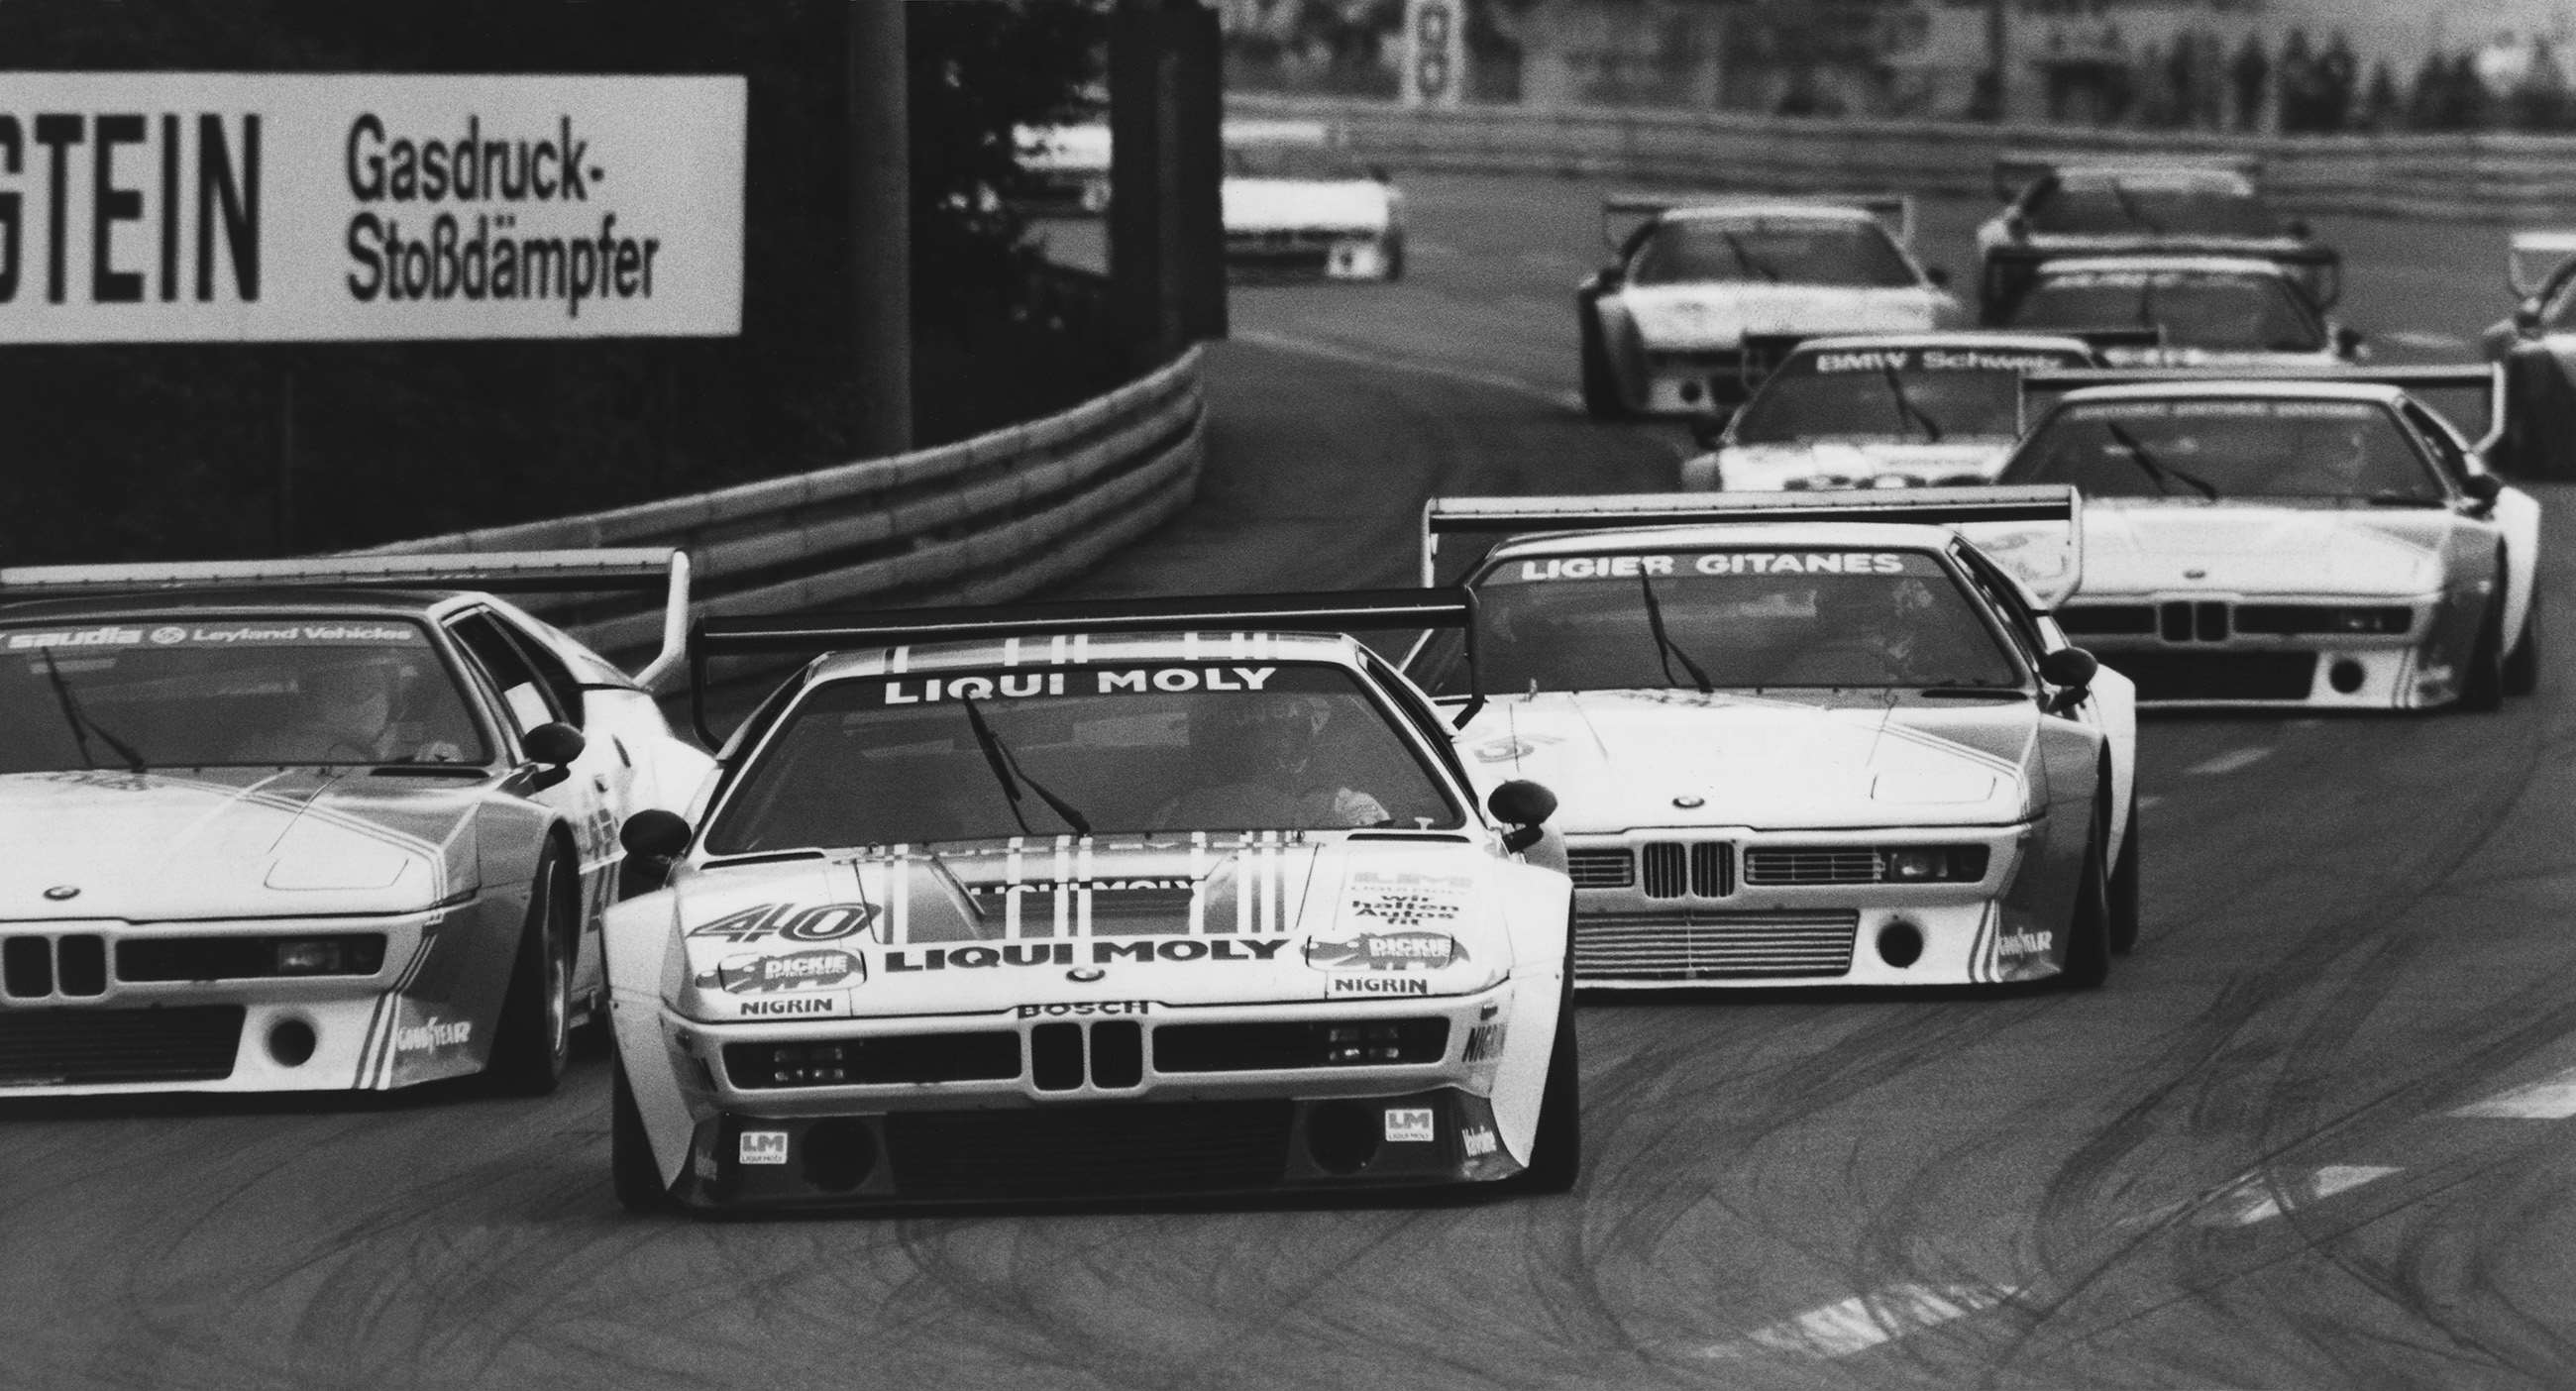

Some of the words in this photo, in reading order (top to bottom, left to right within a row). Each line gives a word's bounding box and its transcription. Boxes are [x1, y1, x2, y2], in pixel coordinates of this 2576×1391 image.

[345, 111, 604, 204] Gasdruck-
[346, 211, 661, 319] Stoßdämpfer
[1815, 351, 1907, 374] BMW
[1521, 555, 1674, 581] LIGIER
[1695, 553, 1904, 575] GITANES
[192, 627, 298, 643] Leyland
[303, 627, 413, 640] Vehicles
[884, 672, 1065, 705] LIQUI
[1097, 666, 1278, 694] MOLY
[685, 903, 883, 942] 40
[884, 942, 1074, 973] LIQUI
[1092, 938, 1291, 965] MOLY
[1334, 978, 1429, 995] NIGRIN
[740, 998, 833, 1016] NIGRIN
[1018, 1000, 1149, 1018] BOSCH
[1388, 1113, 1430, 1129] LM
[742, 1134, 784, 1152] LM
